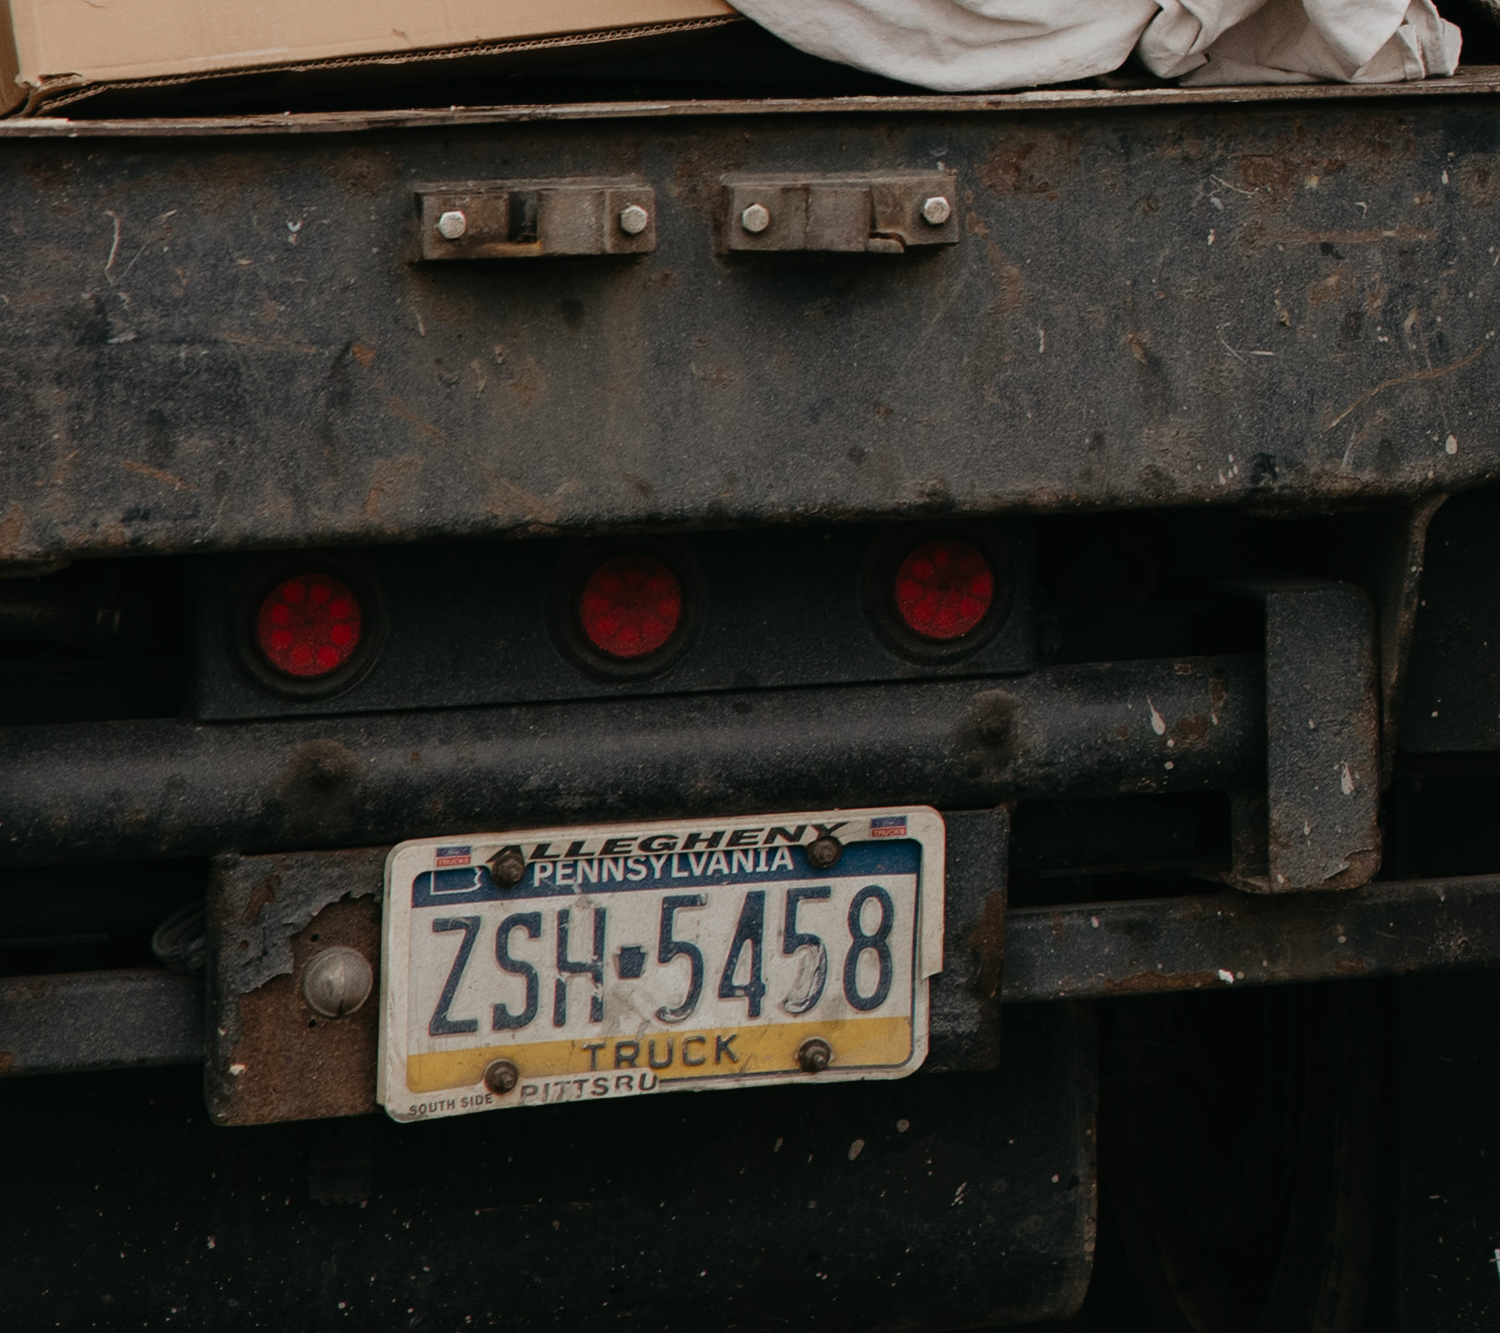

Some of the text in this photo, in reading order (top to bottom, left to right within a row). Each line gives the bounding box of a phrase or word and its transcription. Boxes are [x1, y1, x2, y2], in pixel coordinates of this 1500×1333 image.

[486, 822, 850, 863] ALLEGHENY
[533, 848, 795, 888] PENNSYLVANIA
[582, 1034, 741, 1072] TRUCK
[408, 1093, 494, 1117] SOUTH SIDE
